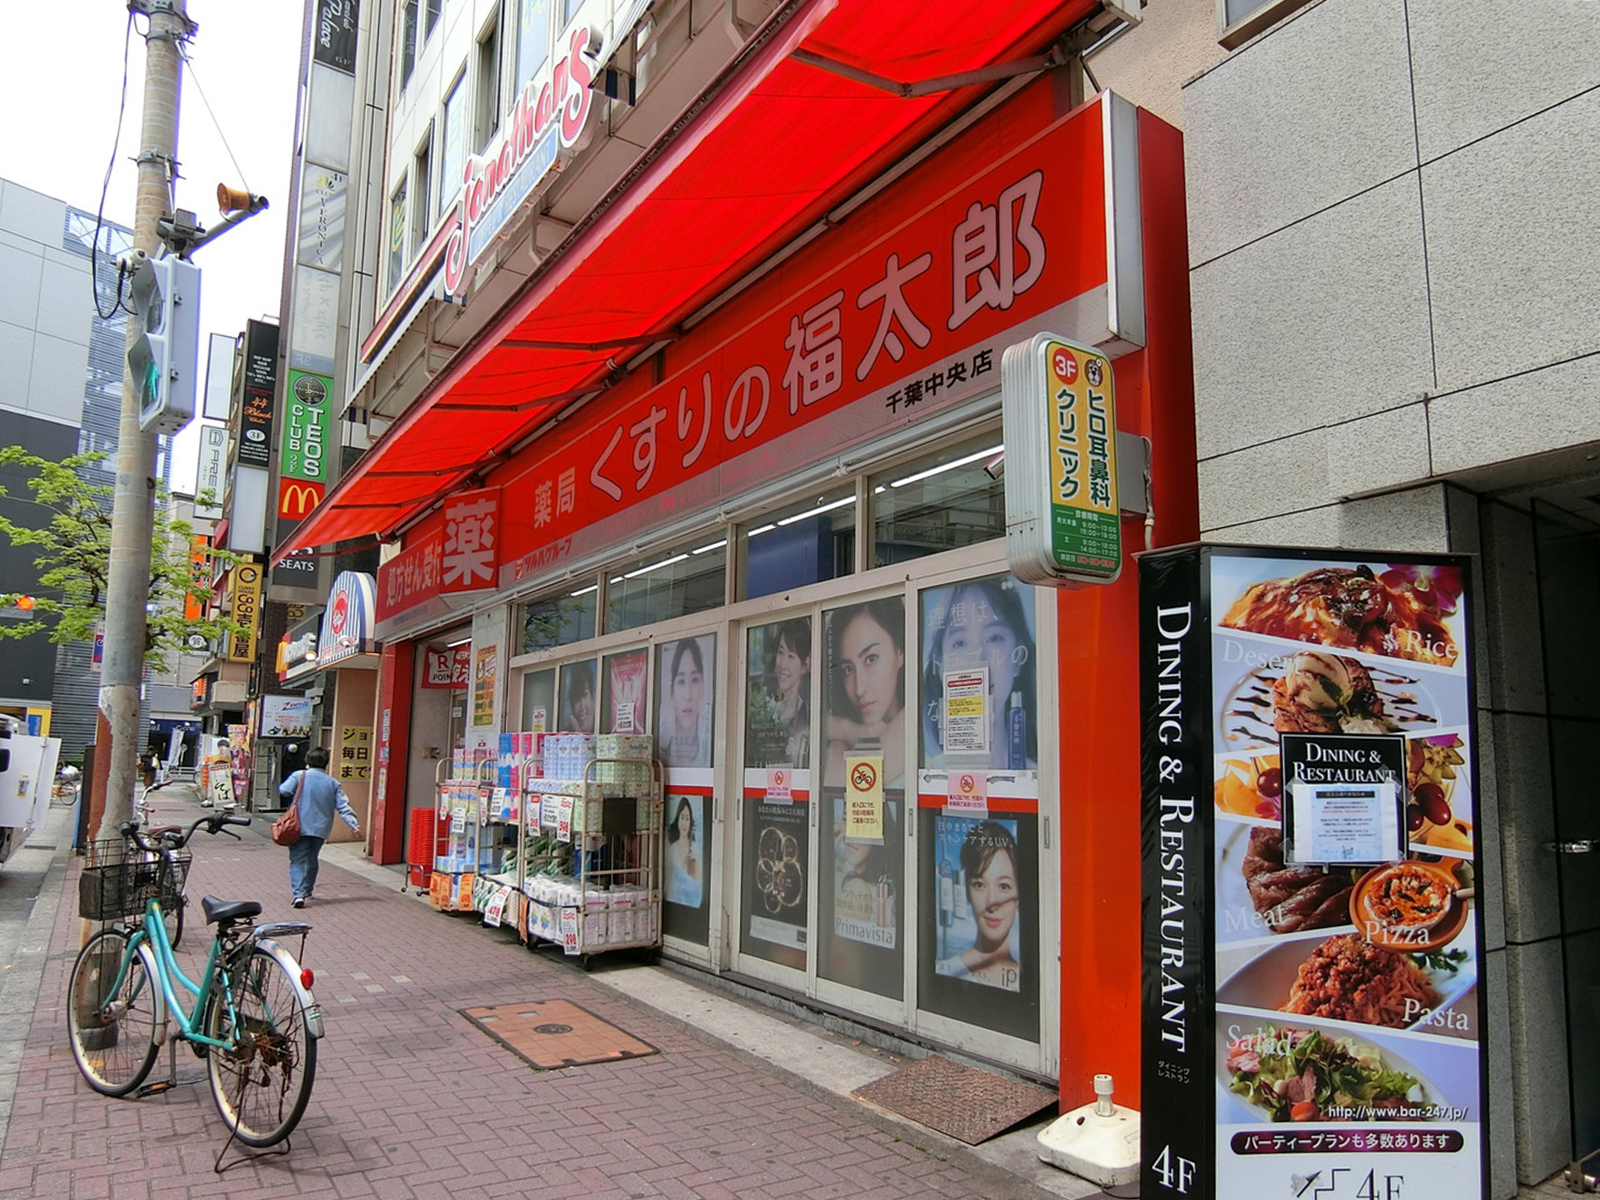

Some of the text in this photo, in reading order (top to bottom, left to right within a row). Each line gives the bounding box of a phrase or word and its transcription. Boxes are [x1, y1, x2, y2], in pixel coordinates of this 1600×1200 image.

[316, 198, 328, 265] VERONICA
[590, 169, 1048, 502] くすりの福太郎
[885, 348, 993, 415] 千葉中央店
[1055, 355, 1077, 378] 3F
[289, 404, 304, 450] CLUB
[303, 407, 324, 477] TEOS
[1057, 388, 1079, 499] クリニック
[1088, 389, 1111, 507] ヒロ耳鼻科
[534, 466, 576, 529] 薬局
[442, 498, 497, 586] 薬
[279, 559, 315, 571] SEATS
[928, 601, 998, 629] 理想は、
[1406, 629, 1457, 659] Rice
[437, 655, 449, 669] R
[342, 746, 367, 760] 毎日
[1305, 742, 1382, 763] DINING &
[341, 765, 372, 778] まで
[1293, 761, 1396, 783] RESTAURANT
[1156, 602, 1196, 1053] DINING & RESTAURANT
[836, 916, 893, 944] Primavista
[1224, 906, 1287, 933] Meat
[1366, 921, 1430, 945] Pizza
[1403, 998, 1469, 1031] Pasta
[1226, 1025, 1292, 1057] Salad
[1328, 1105, 1468, 1121] http://www.bar-247.jp/
[1244, 1133, 1450, 1150] パーティープランも多数あります
[1151, 1144, 1196, 1194] 4F
[1356, 1167, 1405, 1200] 4F
